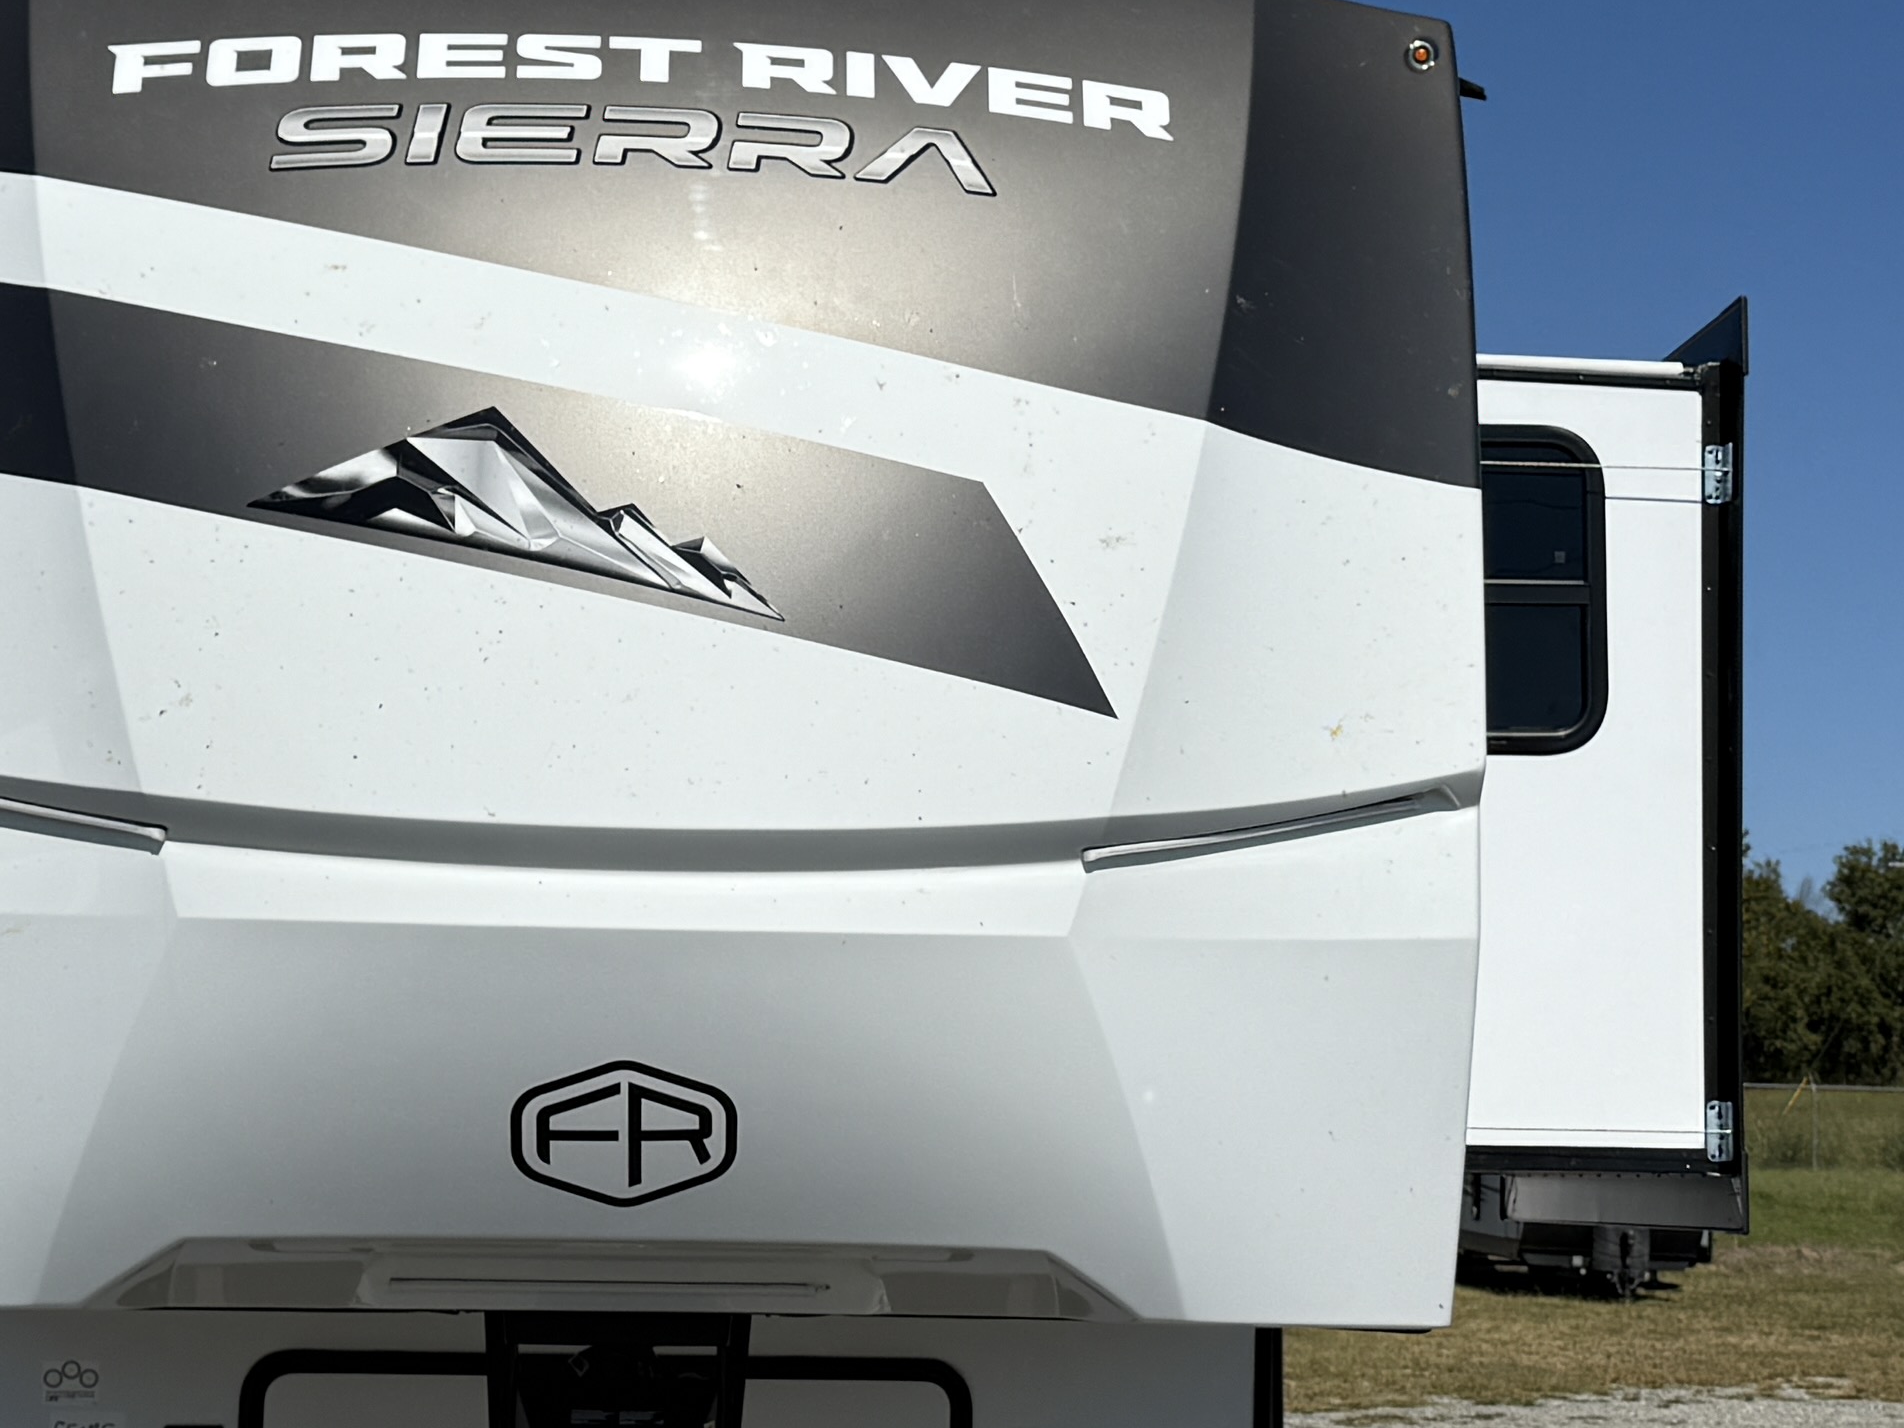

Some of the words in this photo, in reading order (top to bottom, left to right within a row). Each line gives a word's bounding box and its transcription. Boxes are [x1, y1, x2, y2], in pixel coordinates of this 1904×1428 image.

[107, 33, 702, 94] FOREST
[733, 42, 1174, 141] RIVER
[269, 102, 997, 197] SIERRA
